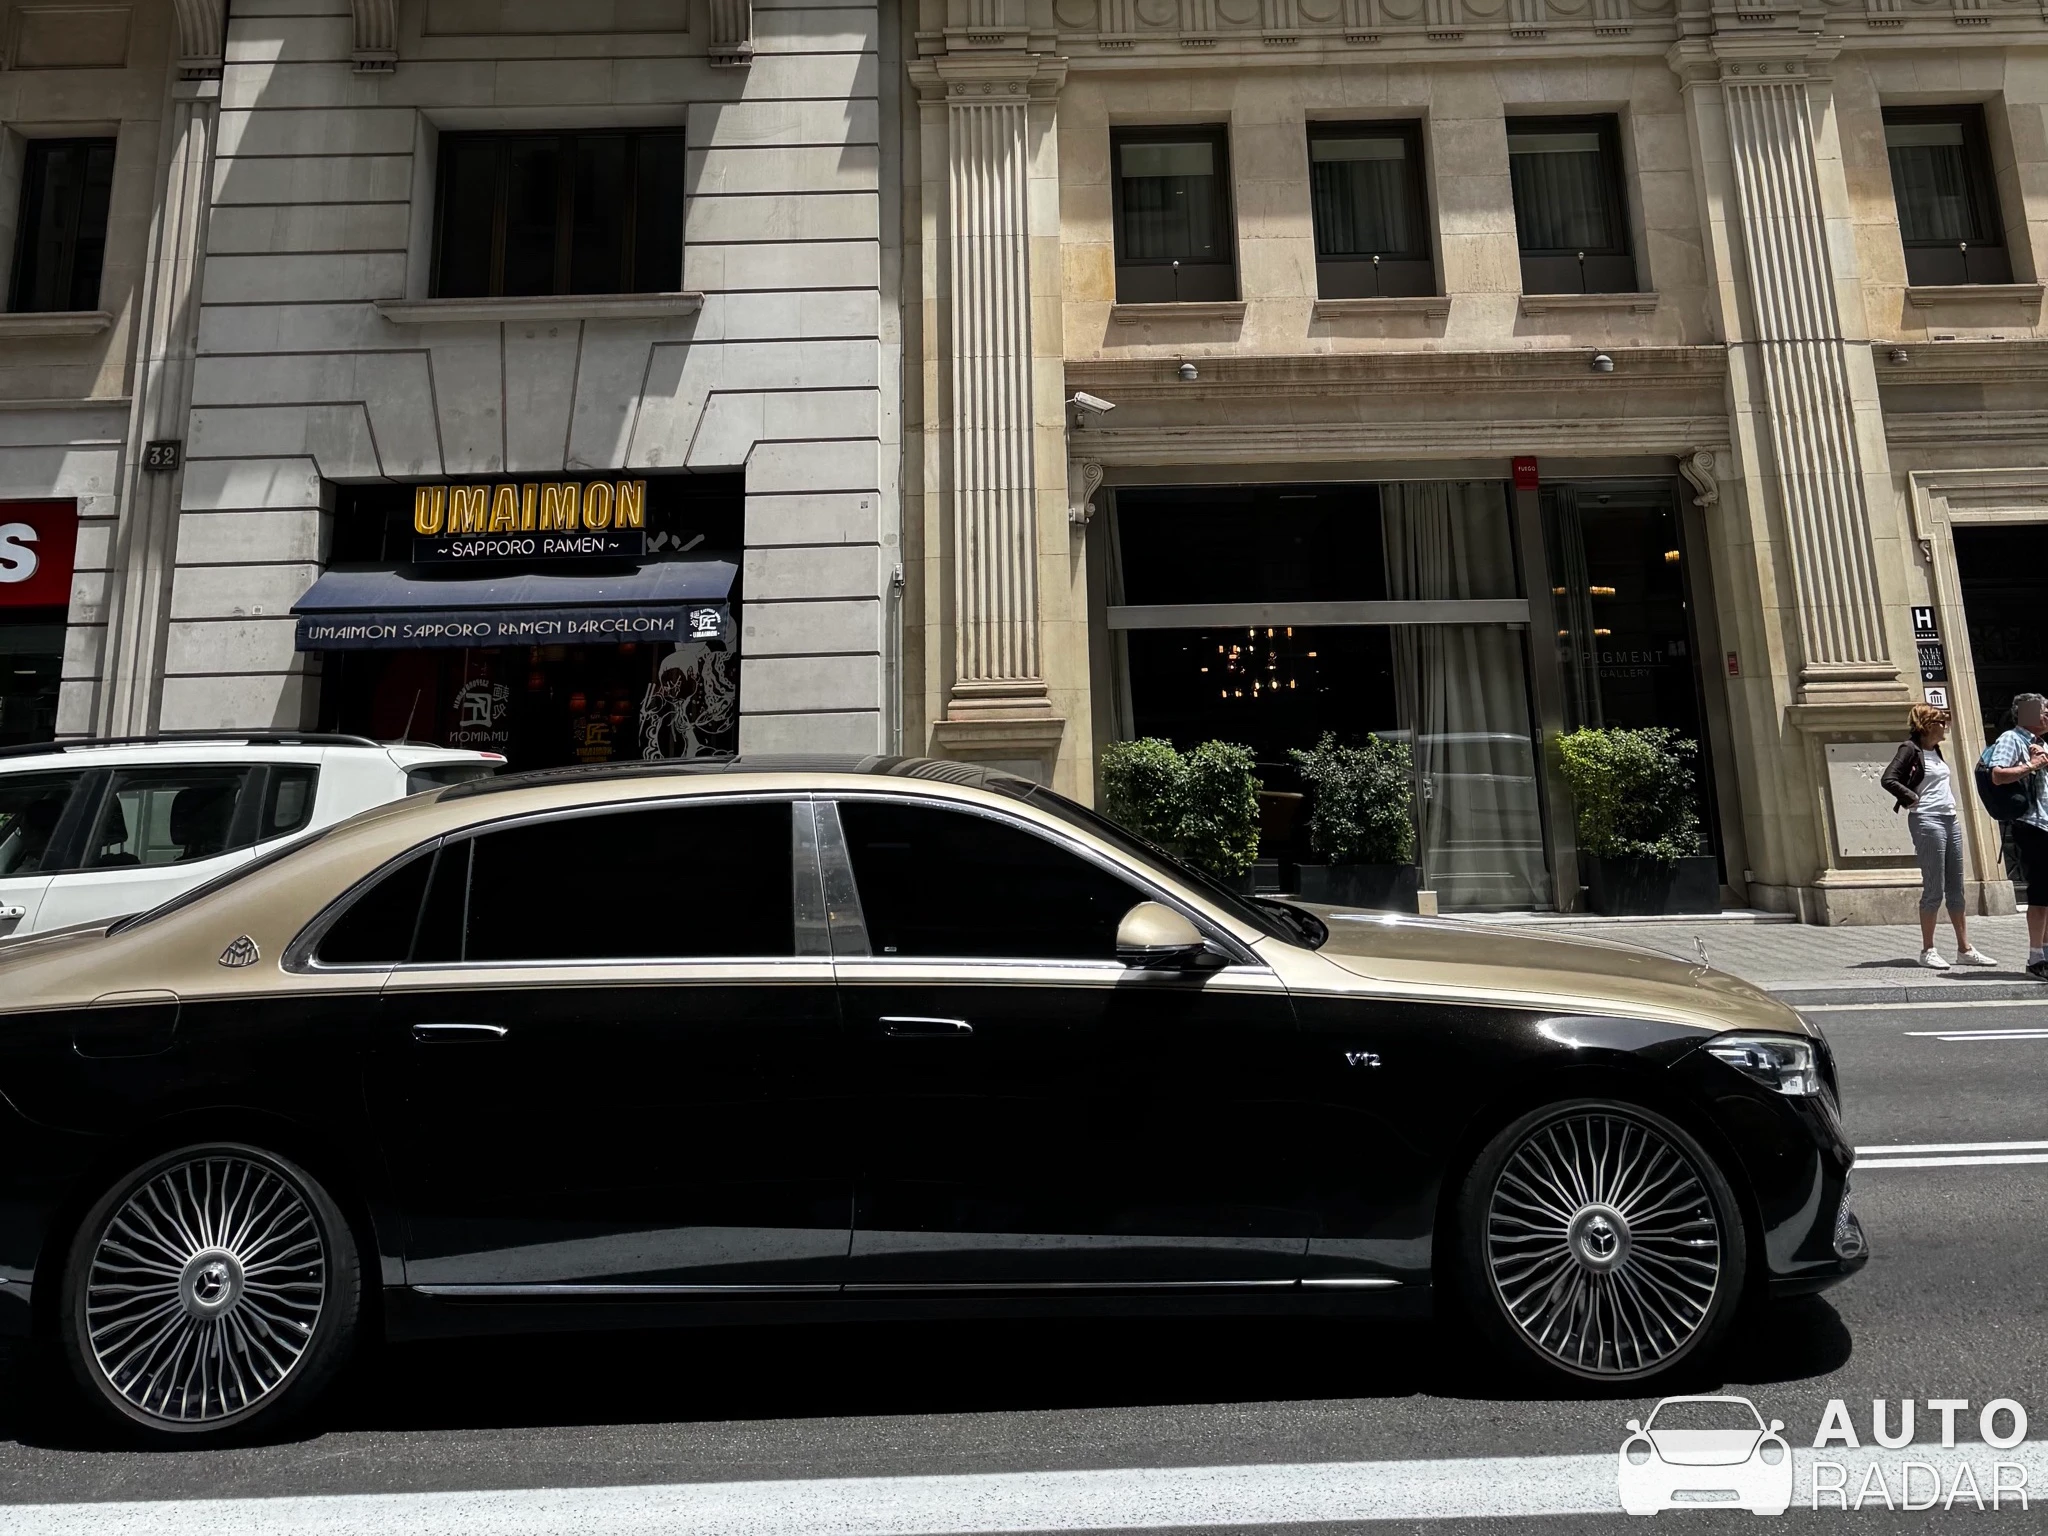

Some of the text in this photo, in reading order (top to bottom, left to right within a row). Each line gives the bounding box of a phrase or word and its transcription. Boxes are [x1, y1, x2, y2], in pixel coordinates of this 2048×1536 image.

[150, 446, 175, 465] 32
[414, 480, 647, 535] UMAIMON
[0, 522, 39, 583] S
[308, 617, 675, 640] UMAIMON SAPPORO RAMEN BARCELONA
[1915, 609, 1932, 629] H
[1583, 650, 1663, 663] PIGMENT
[1345, 1052, 1381, 1067] V12
